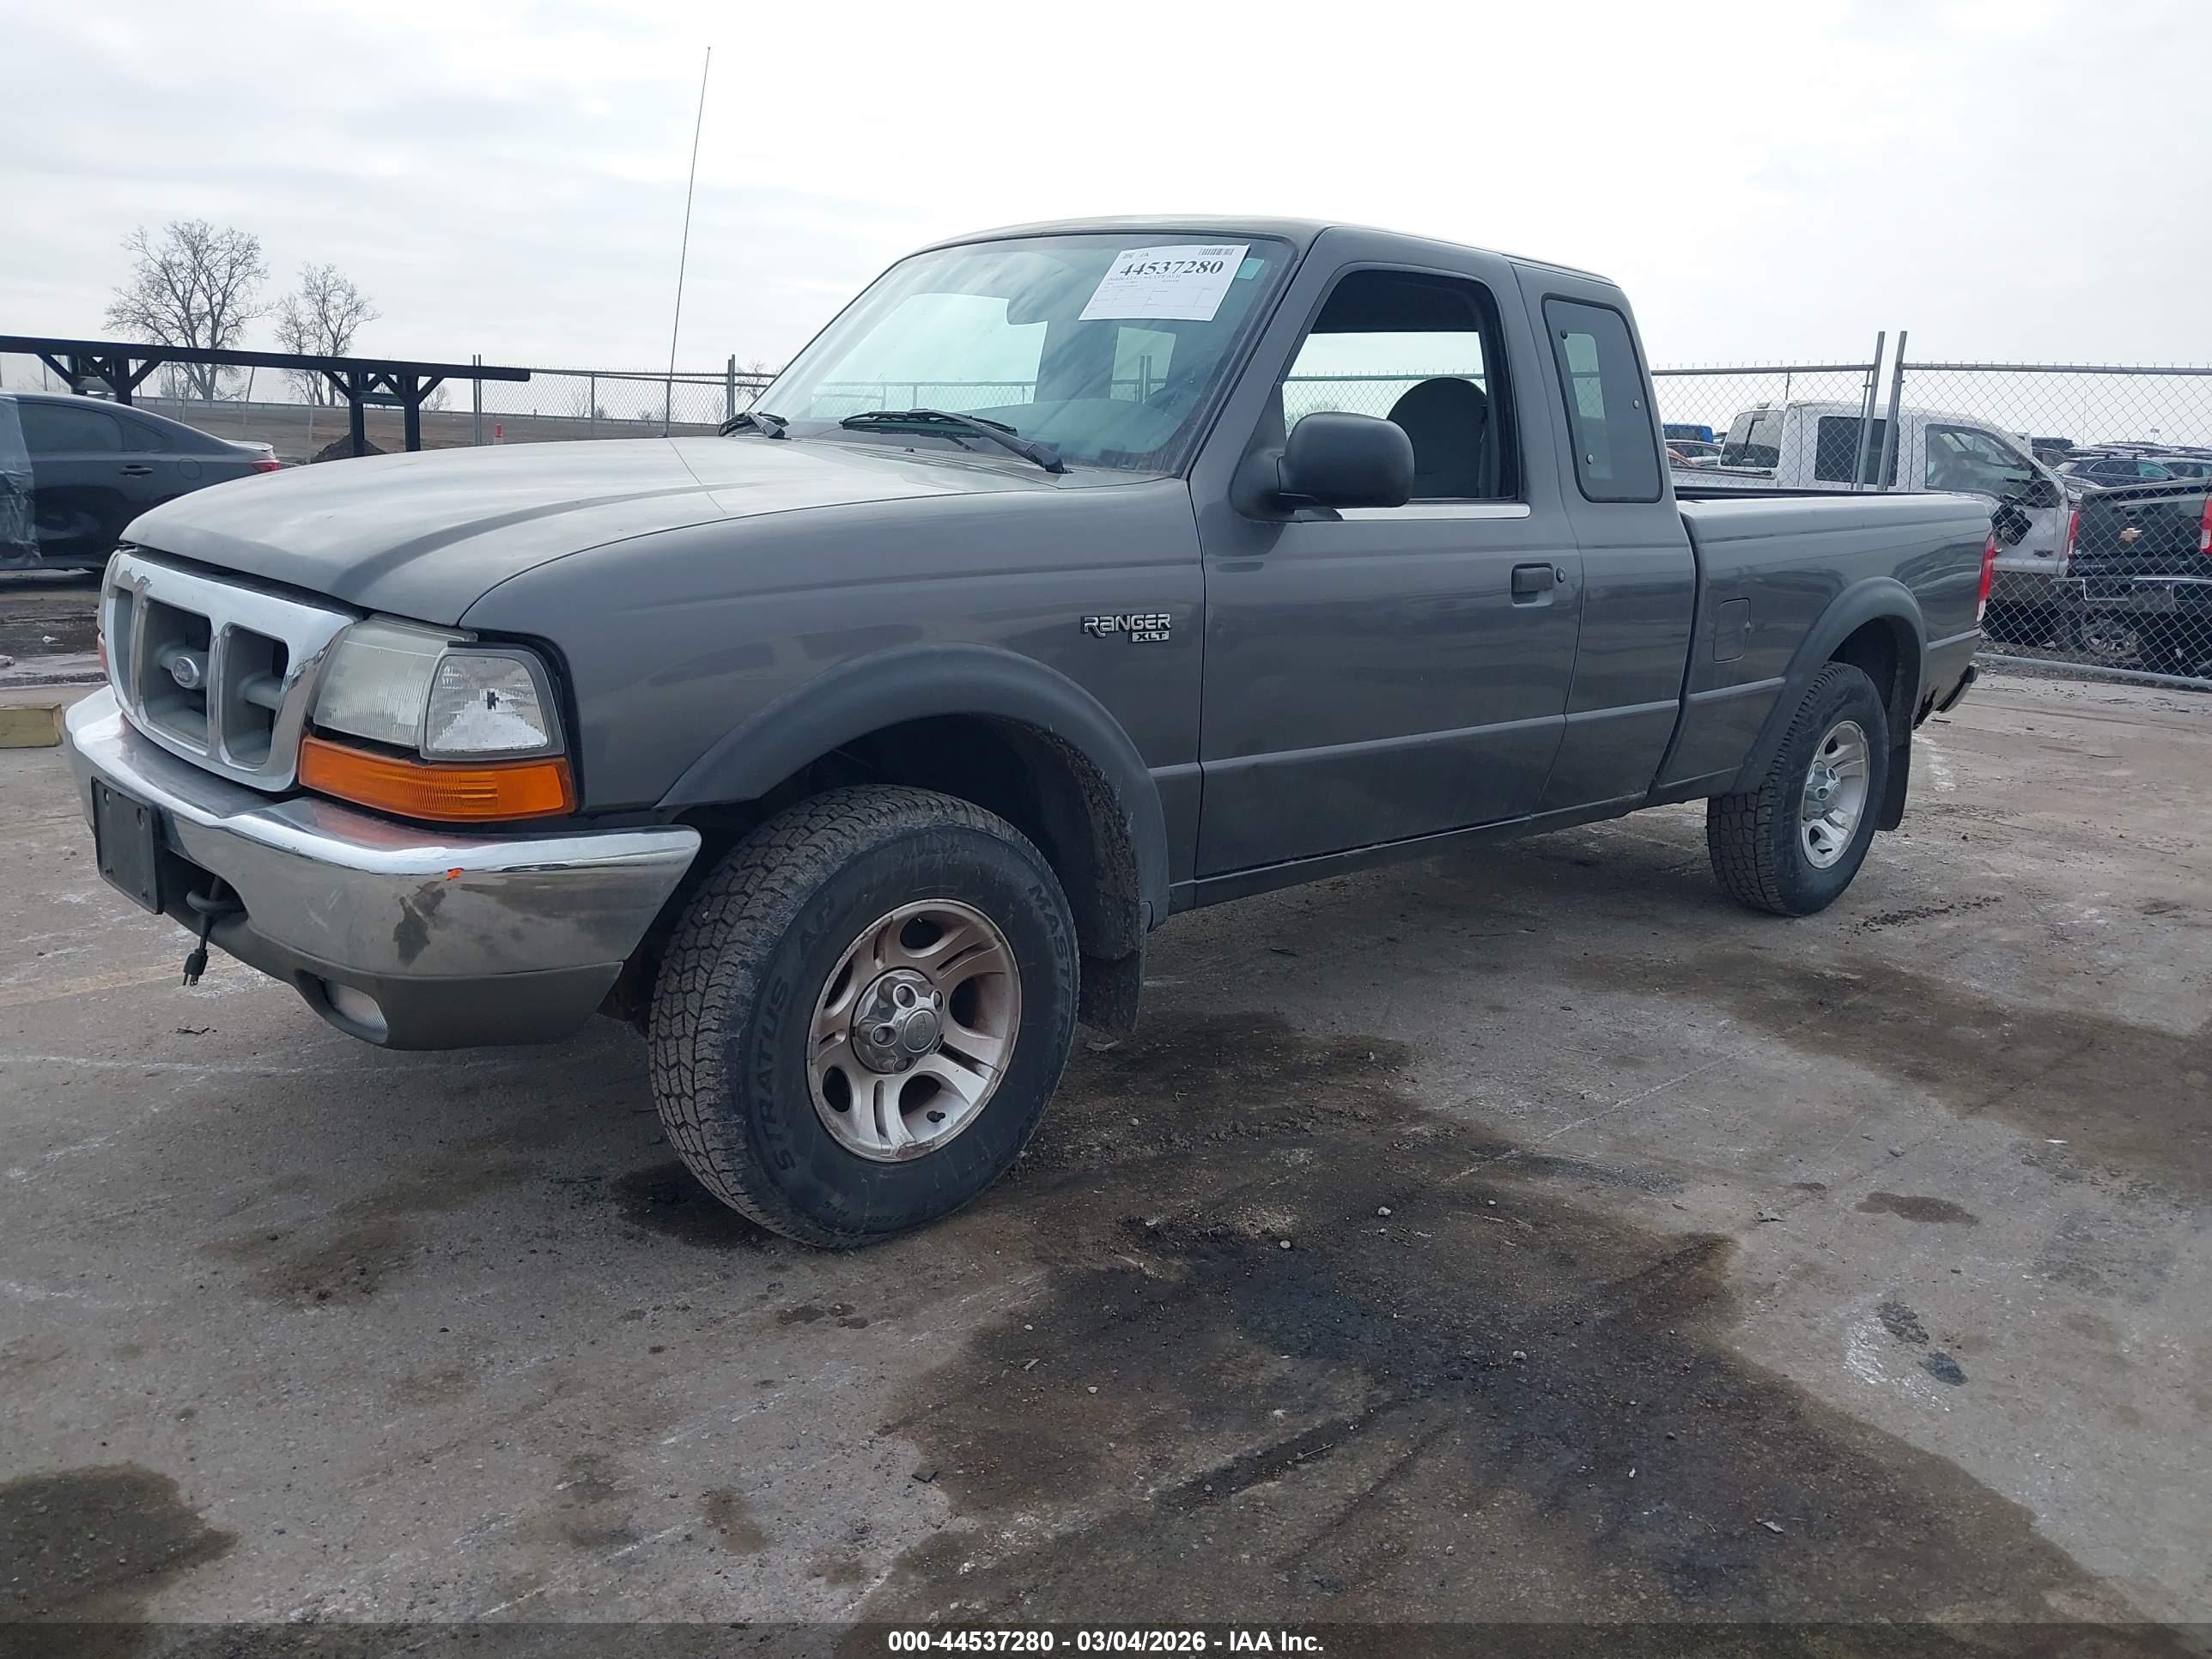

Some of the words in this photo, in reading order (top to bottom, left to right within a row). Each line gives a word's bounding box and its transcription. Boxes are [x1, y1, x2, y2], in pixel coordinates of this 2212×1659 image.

[1120, 260, 1224, 276] 44537280
[1082, 614, 1171, 637] RANGER
[1134, 631, 1168, 641] XLT
[755, 975, 797, 1171] STRATUS
